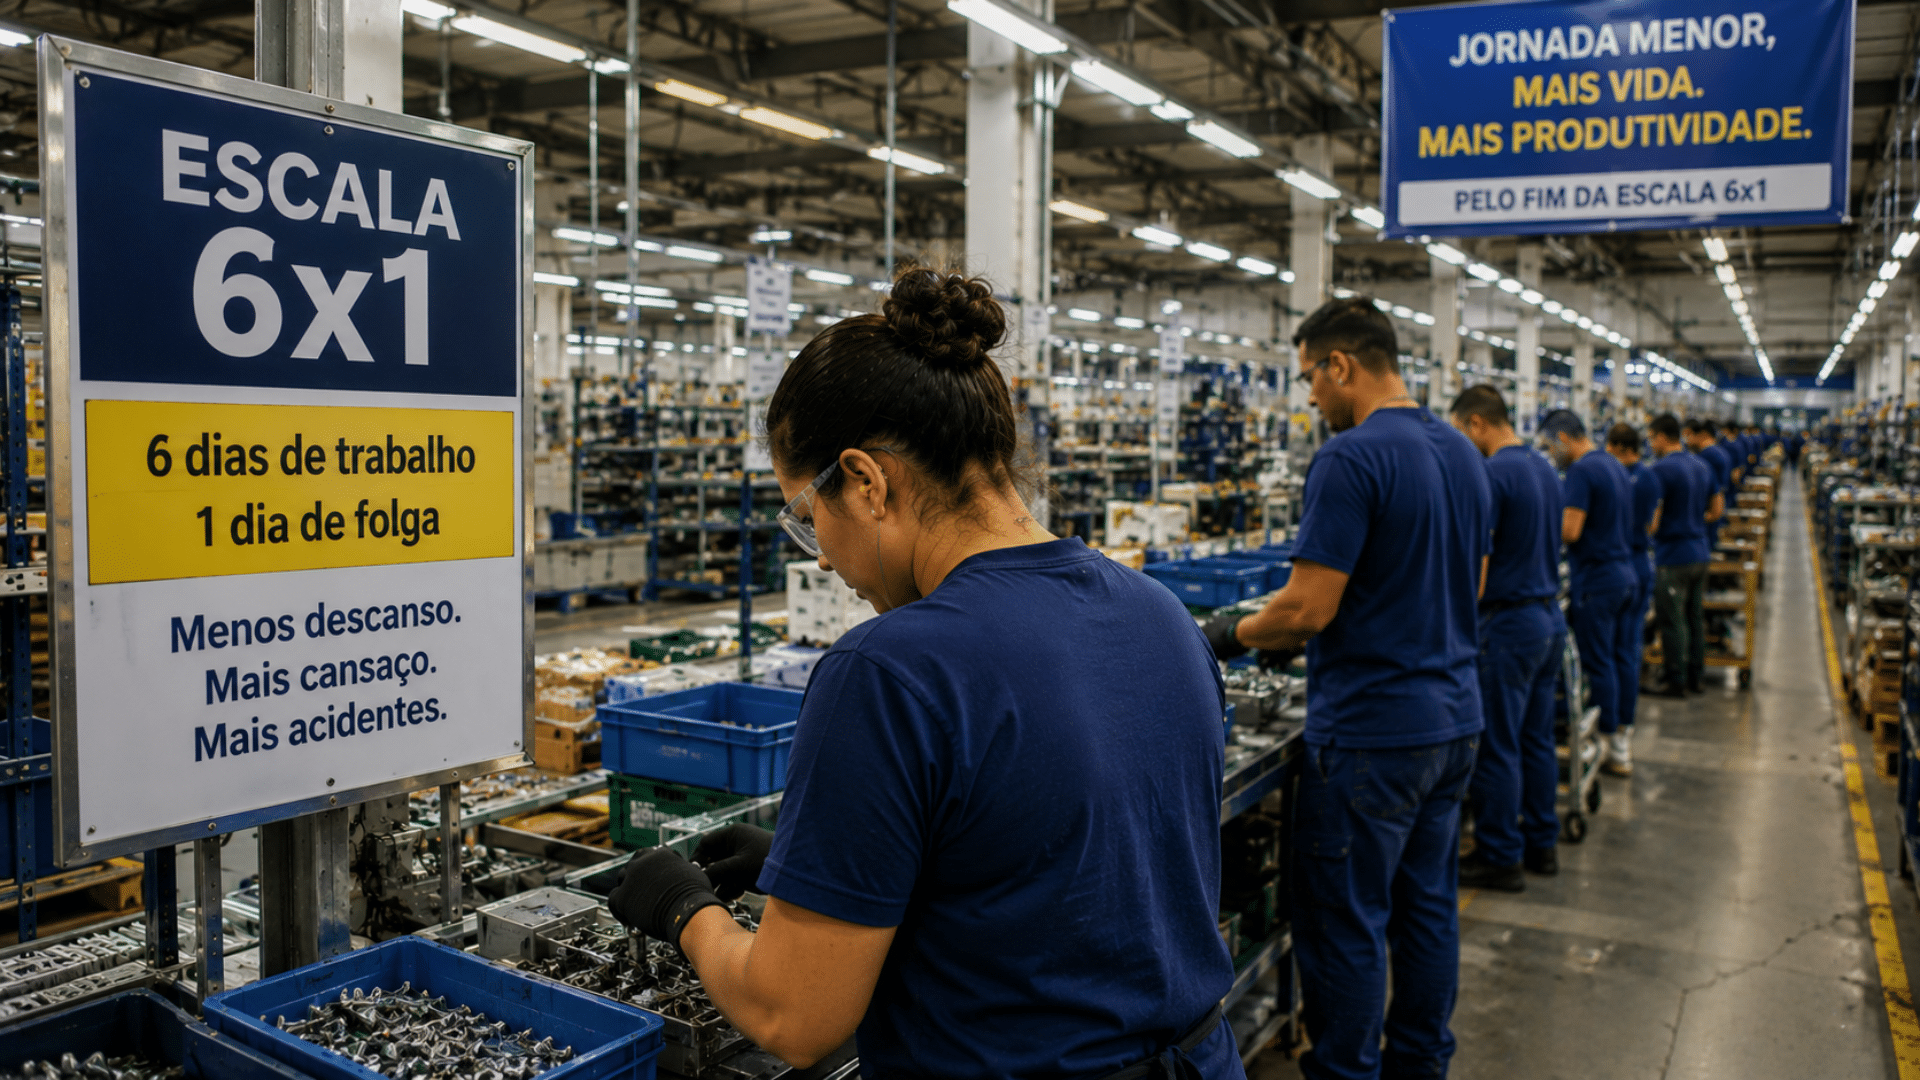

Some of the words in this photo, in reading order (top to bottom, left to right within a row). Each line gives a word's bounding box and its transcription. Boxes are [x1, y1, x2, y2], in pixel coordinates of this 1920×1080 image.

[1449, 23, 1619, 67] JORNADA
[1629, 13, 1776, 56] MENOR,
[1513, 71, 1600, 108] MAIS
[1608, 65, 1704, 102] VIDA.
[1419, 122, 1503, 158] MAIS
[1512, 107, 1812, 153] PRODUTIVIDADE.
[162, 129, 461, 241] ESCALA
[1455, 189, 1515, 212] PELO
[1524, 187, 1566, 208] FIM
[1575, 186, 1608, 208] DA
[1617, 182, 1716, 207] ESCALA
[1725, 179, 1766, 202] 6x1
[193, 227, 429, 366] 6x1
[147, 434, 172, 477] 6
[185, 432, 268, 476] dias
[280, 434, 326, 475] de
[335, 434, 476, 475] trabalho
[197, 506, 212, 546] 1
[231, 502, 289, 545] dia
[301, 501, 345, 542] de
[355, 498, 439, 547] folga
[170, 614, 295, 653] Menos
[305, 599, 462, 639] descanso.
[206, 661, 290, 705] Mais
[300, 651, 437, 692] cansaço.
[194, 716, 279, 762] Mais
[288, 696, 448, 746] acidentes.
